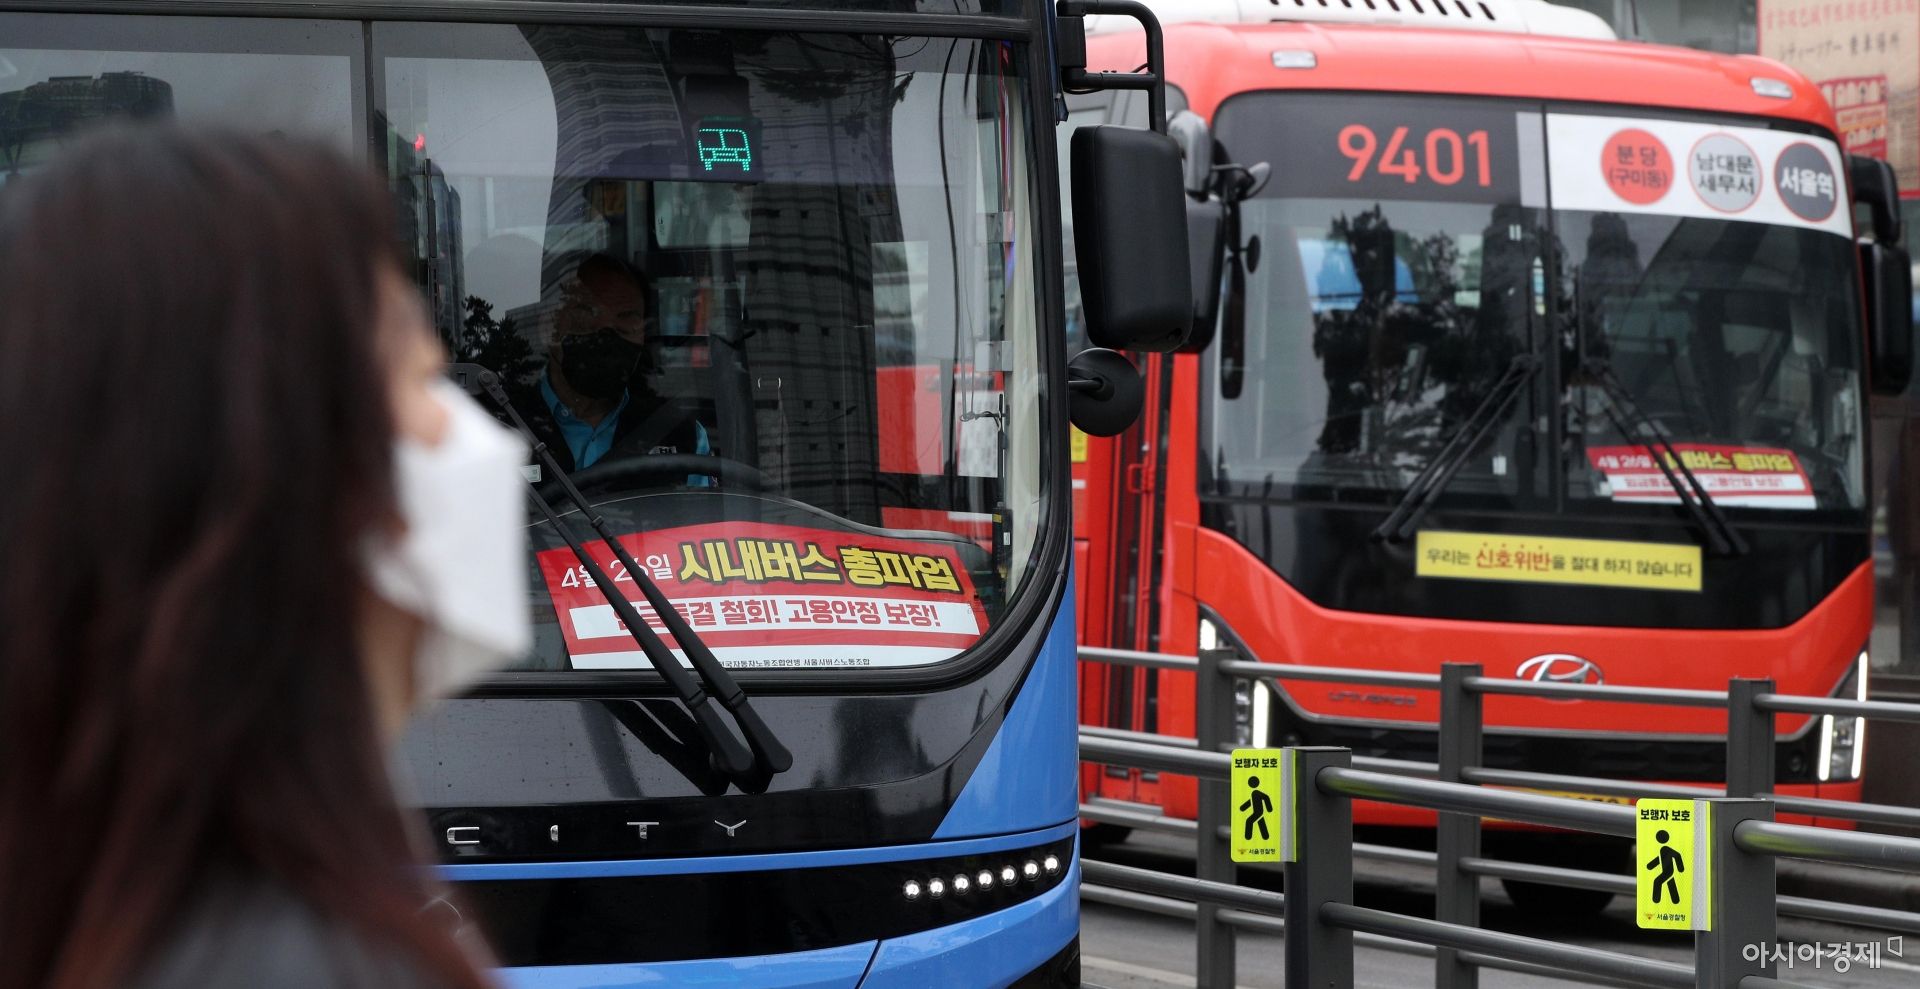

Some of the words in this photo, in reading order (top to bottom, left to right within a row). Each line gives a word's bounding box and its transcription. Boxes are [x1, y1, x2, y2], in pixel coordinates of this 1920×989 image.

[1338, 124, 1492, 187] 9401
[1696, 152, 1754, 175] 남대문
[1609, 167, 1668, 189] (구미동)
[1698, 174, 1755, 196] 세무서
[1780, 166, 1834, 202] 서울역
[1732, 452, 1795, 472] 총파업
[678, 539, 844, 583] 시내버스
[838, 547, 962, 593] 총파업
[1427, 548, 1470, 566] 우리는
[1476, 547, 1565, 572] 신호위반을
[1571, 555, 1599, 572] 절대
[1603, 557, 1631, 574] 하지
[1636, 559, 1692, 577] 않습니다
[613, 600, 717, 631] 금동결
[720, 599, 780, 627] 철회!
[788, 599, 881, 625] 고용안정
[884, 602, 942, 627] 보장!
[1234, 758, 1259, 768] 보행자
[1262, 758, 1278, 768] 보호
[1640, 809, 1669, 821] 보행자
[1671, 810, 1691, 821] 보호
[1656, 913, 1686, 922] 서울경찰청
